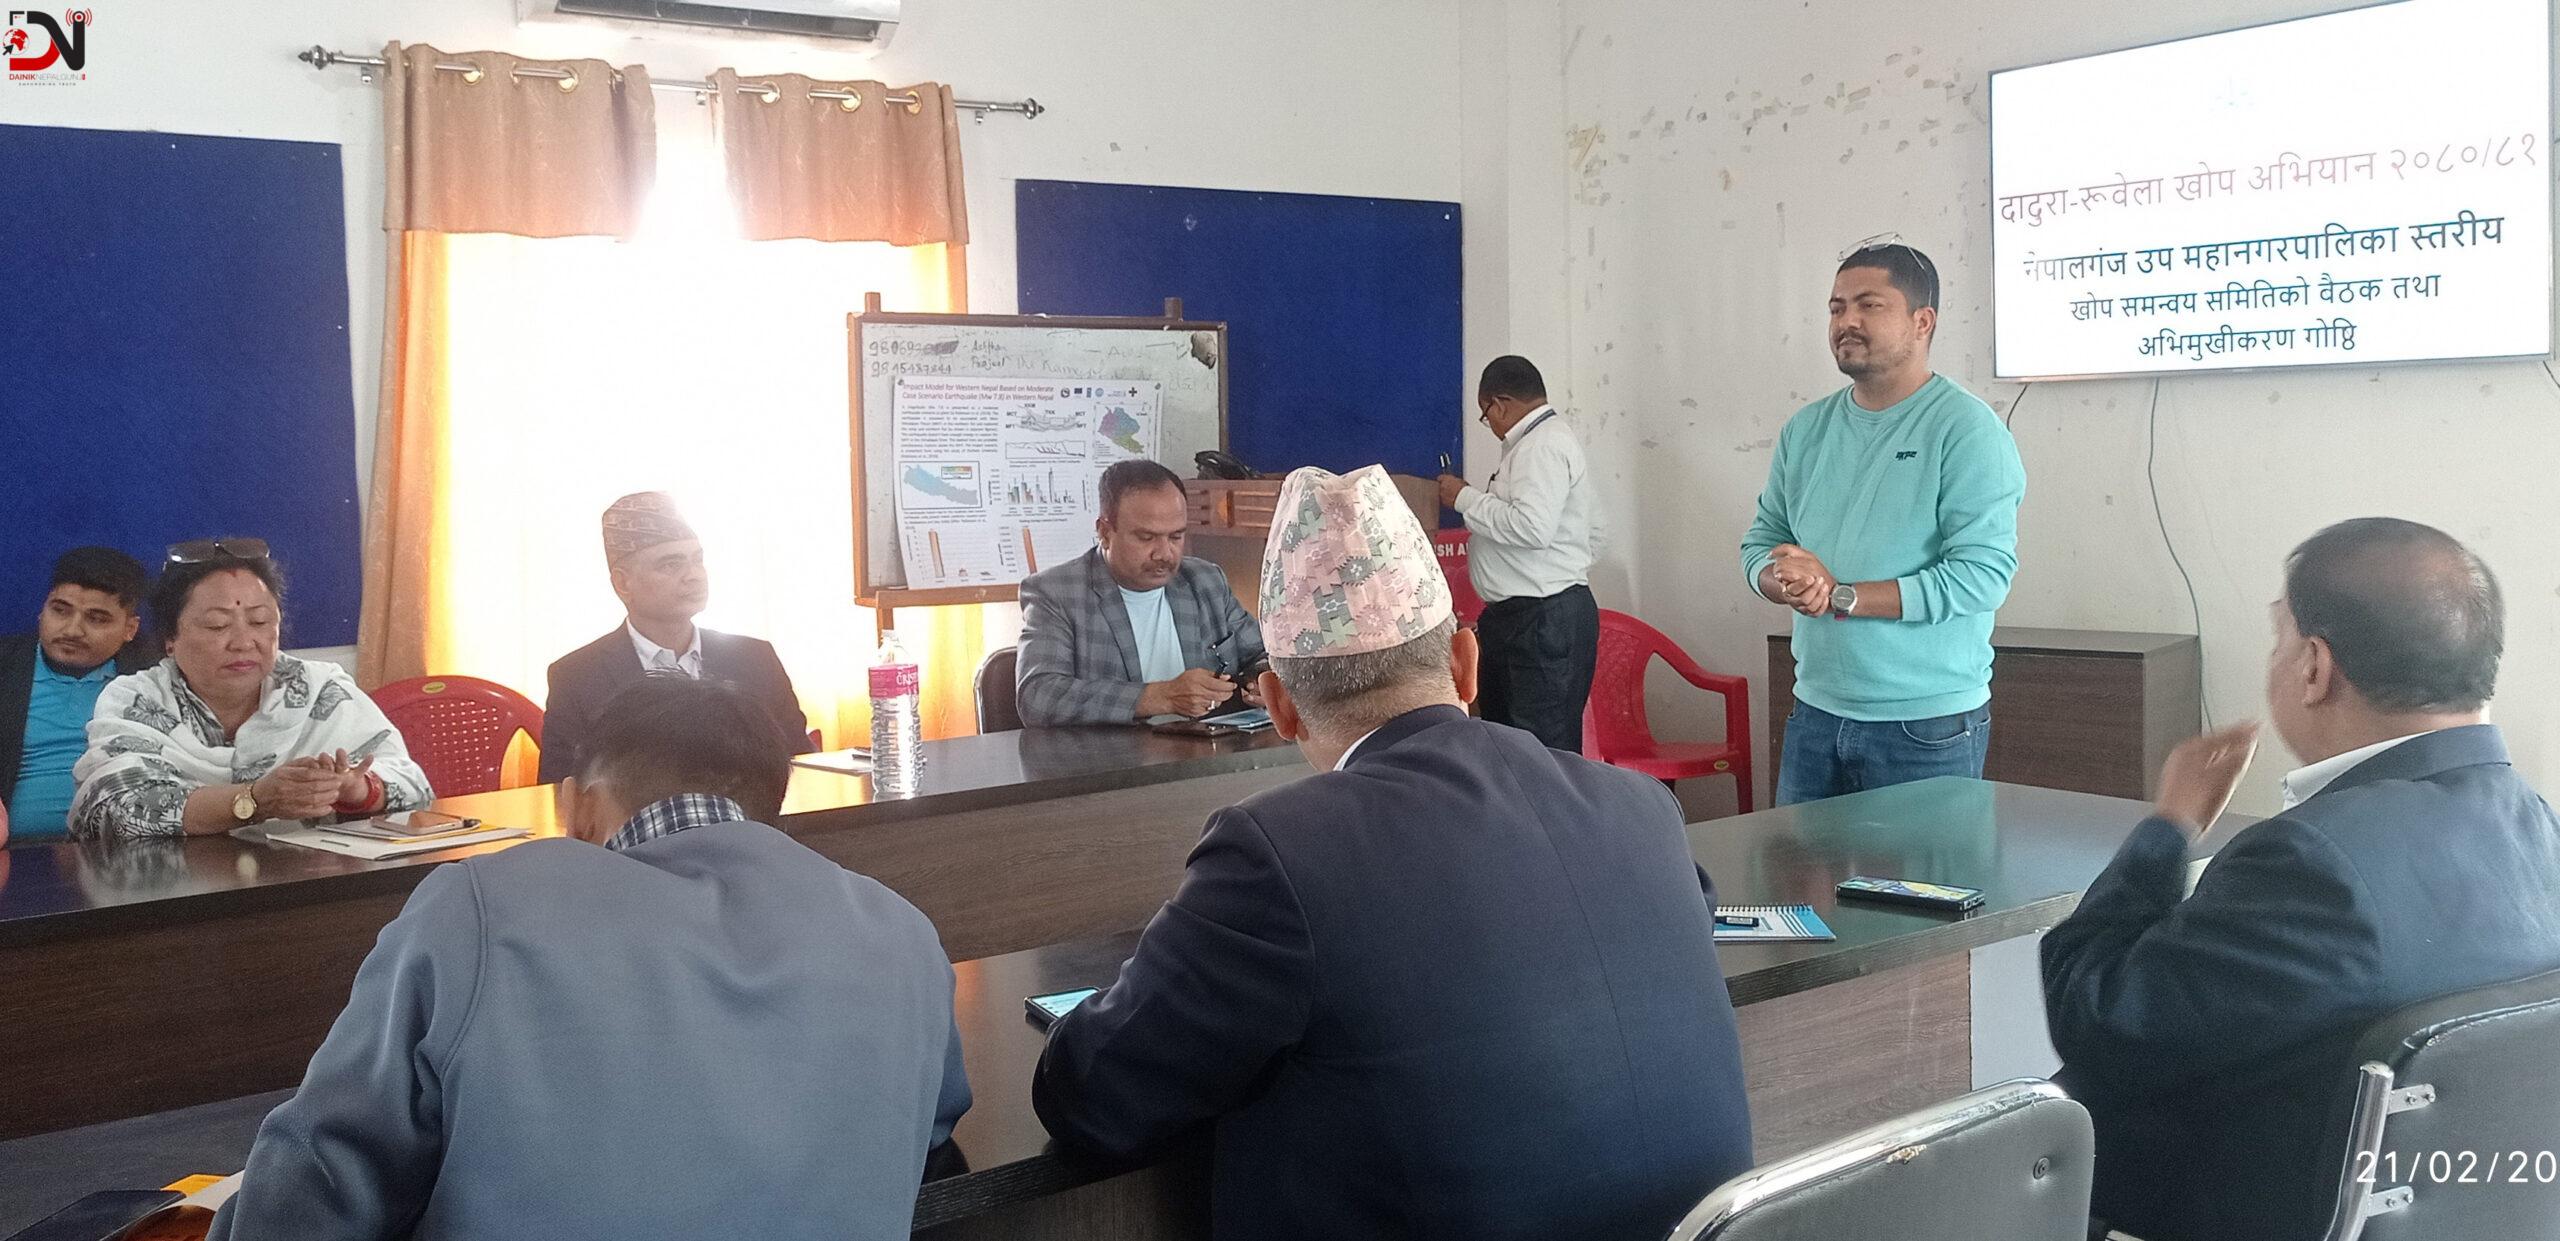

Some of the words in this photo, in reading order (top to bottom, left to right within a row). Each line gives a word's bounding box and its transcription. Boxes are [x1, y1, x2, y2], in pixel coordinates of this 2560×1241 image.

[2174, 162, 2236, 201] खोप
[2249, 152, 2377, 191] अभियान
[2391, 133, 2536, 180] २०८०/८१
[2135, 248, 2174, 274] उप
[2181, 222, 2400, 272] महानगरपालिका
[2408, 209, 2505, 251] स्तरीय
[2070, 292, 2114, 321] खोप
[2120, 293, 2198, 317] समन्वय
[2204, 275, 2311, 312] समितिको
[2317, 272, 2384, 304] वैठक
[2391, 274, 2442, 299] तथा
[2138, 324, 2297, 361] अभिमुखीकरण
[902, 392, 917, 400] Case
[918, 392, 944, 400] Scenario
[945, 392, 978, 401] Earthquake
[1037, 394, 1054, 402] Nepal
[981, 384, 999, 392] Nepal
